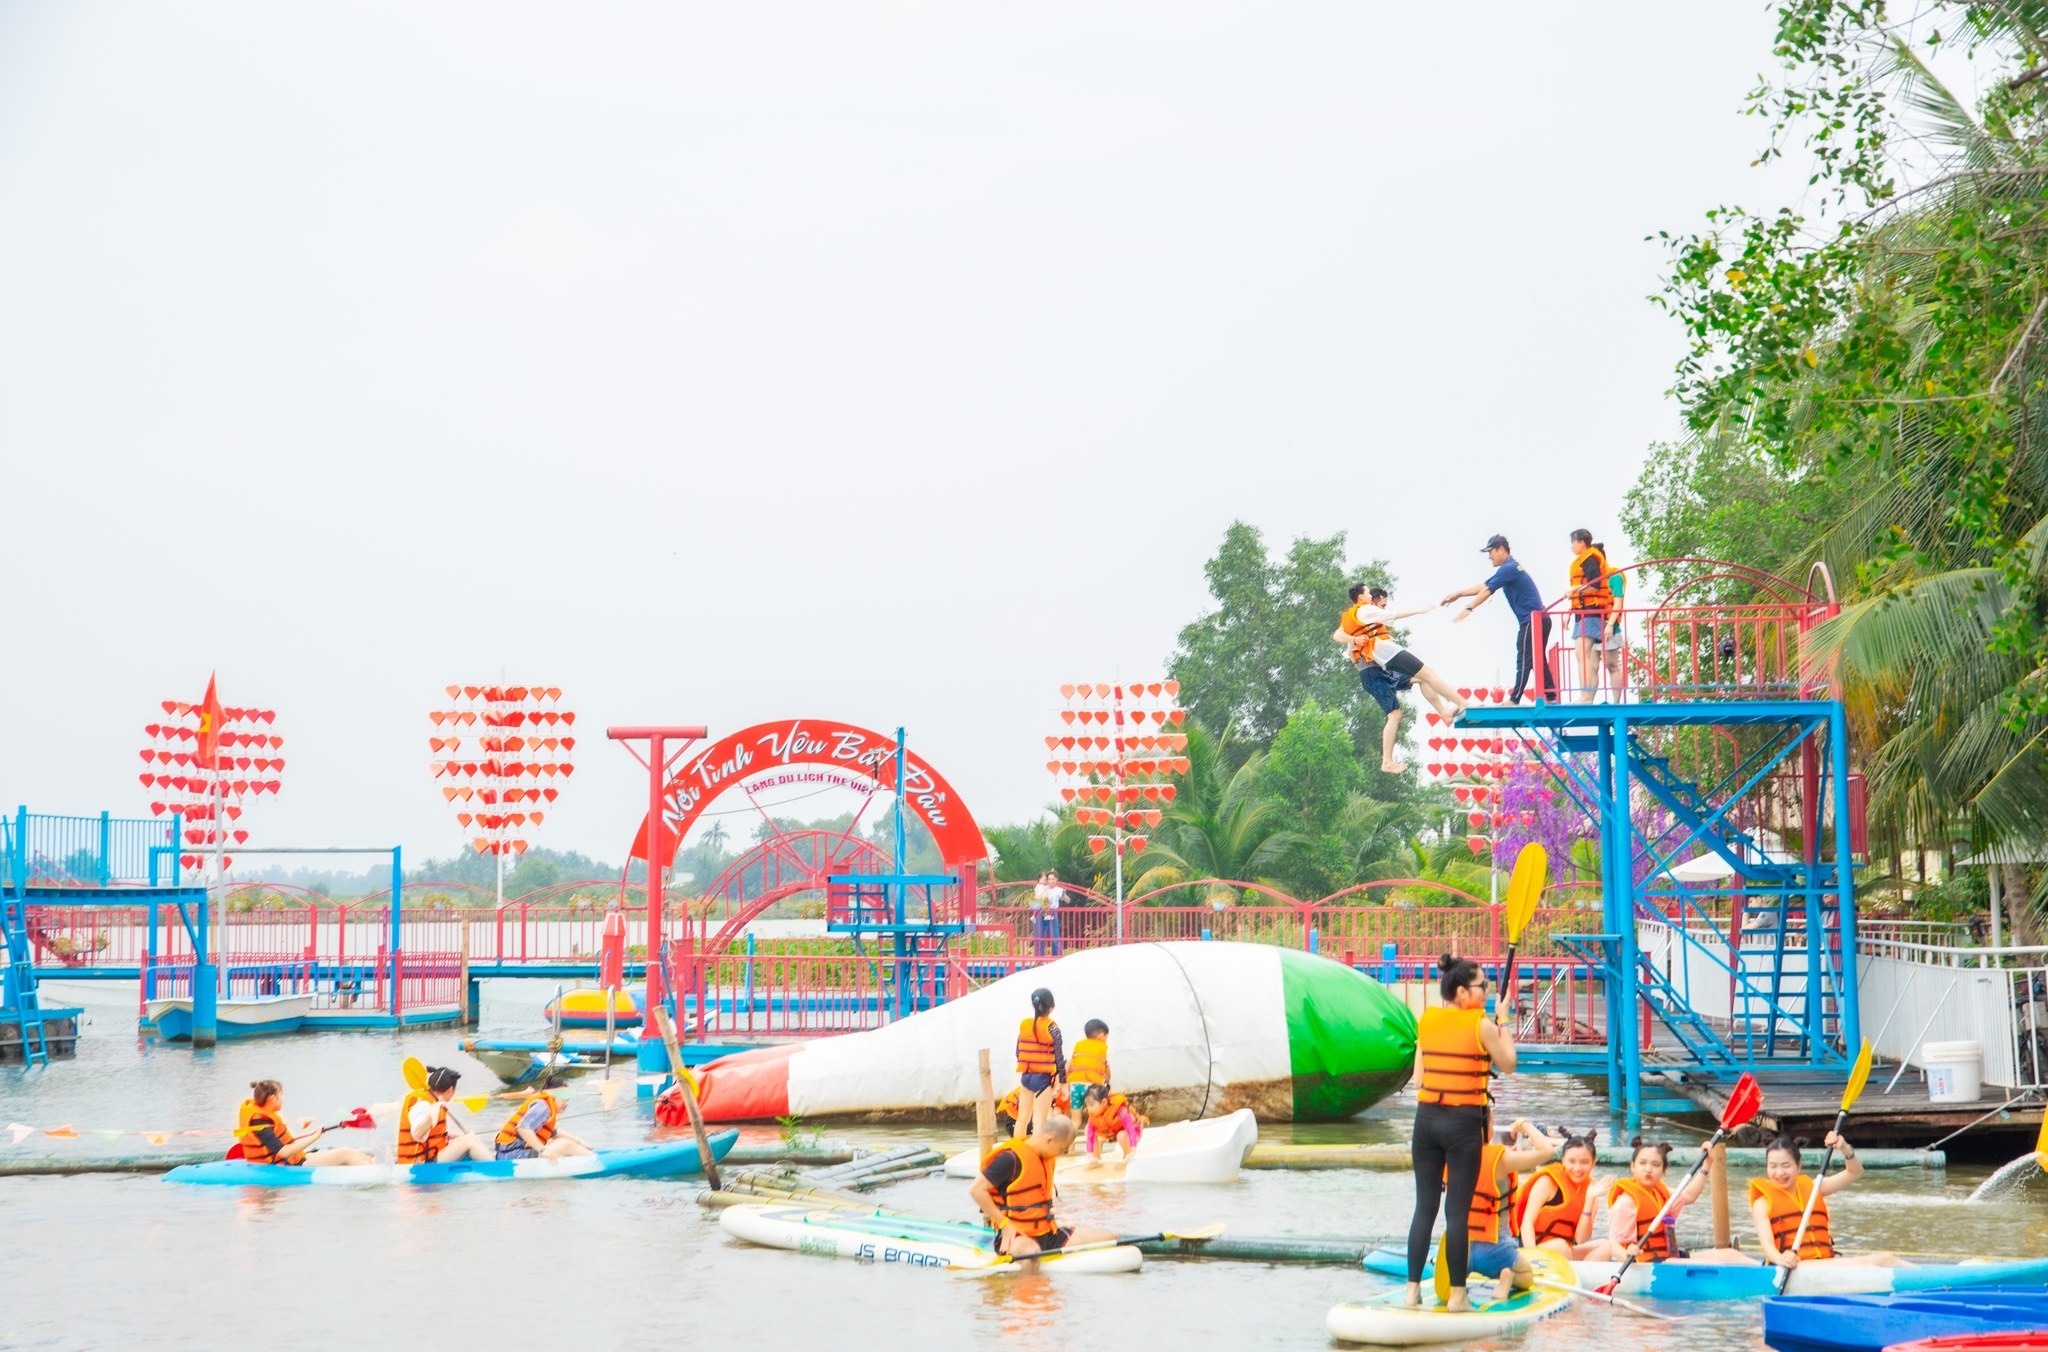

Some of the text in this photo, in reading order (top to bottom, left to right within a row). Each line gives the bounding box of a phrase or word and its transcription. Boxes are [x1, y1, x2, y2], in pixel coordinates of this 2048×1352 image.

[690, 743, 754, 789] Tình
[756, 720, 828, 764] Yêu
[779, 774, 795, 785] DU
[827, 774, 848, 786] TRE
